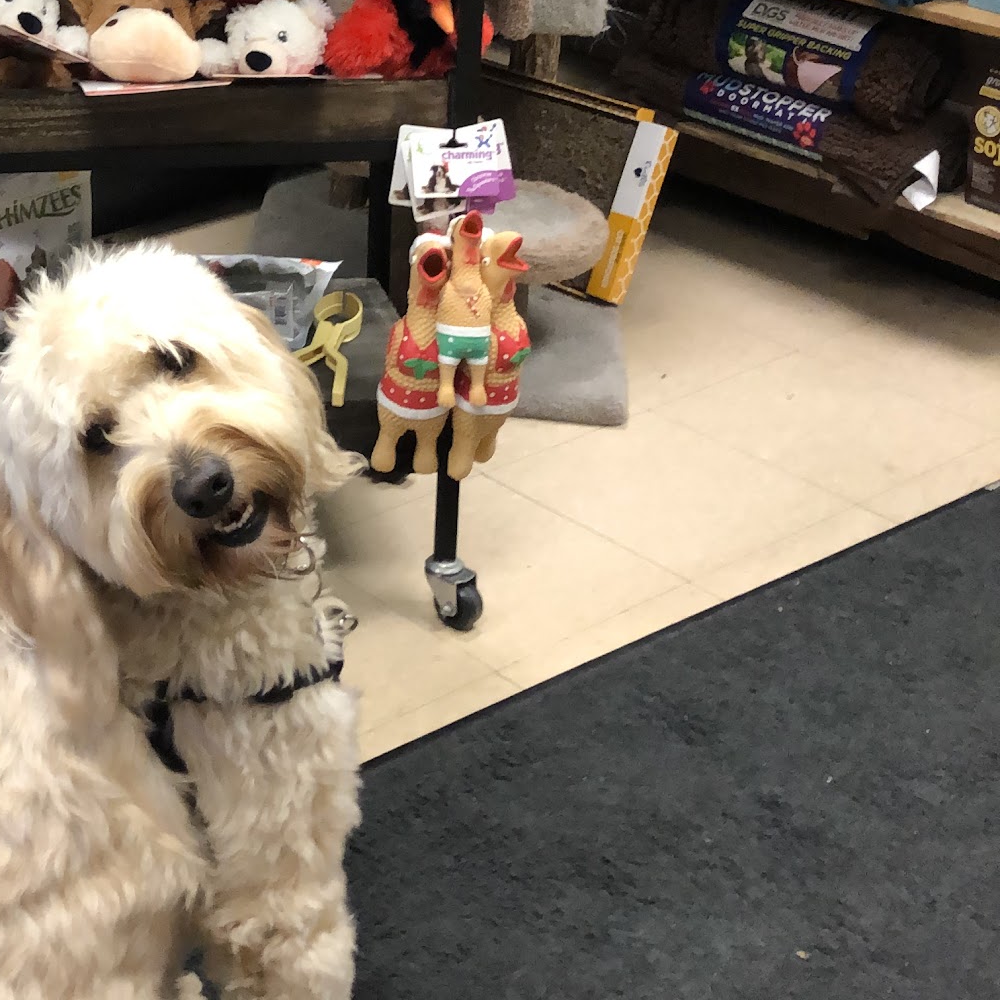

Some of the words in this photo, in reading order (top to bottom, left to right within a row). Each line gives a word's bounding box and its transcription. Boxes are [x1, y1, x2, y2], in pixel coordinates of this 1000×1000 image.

[752, 2, 790, 21] DGS
[736, 19, 766, 34] SUPER
[767, 28, 807, 47] GRIPPER
[807, 40, 852, 61] BACKING
[441, 149, 493, 162] charming
